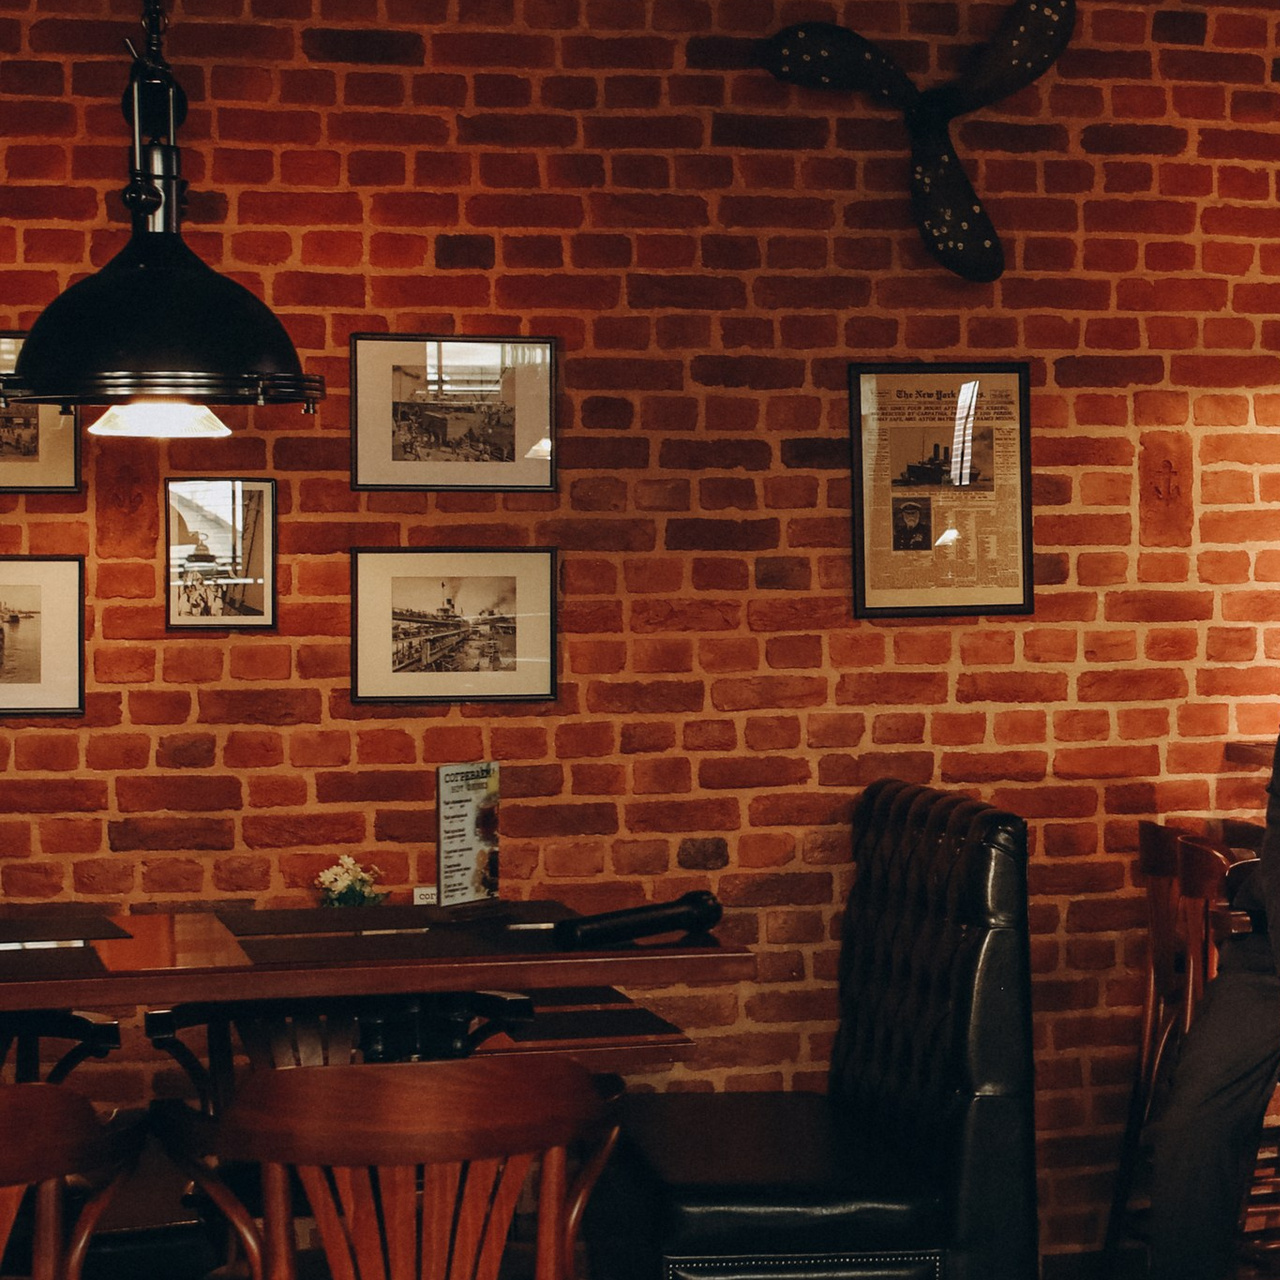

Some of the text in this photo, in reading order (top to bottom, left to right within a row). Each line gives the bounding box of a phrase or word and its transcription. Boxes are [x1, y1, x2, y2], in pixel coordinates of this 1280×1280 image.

[896, 389, 914, 399] The
[915, 389, 934, 399] New
[935, 389, 956, 401] York
